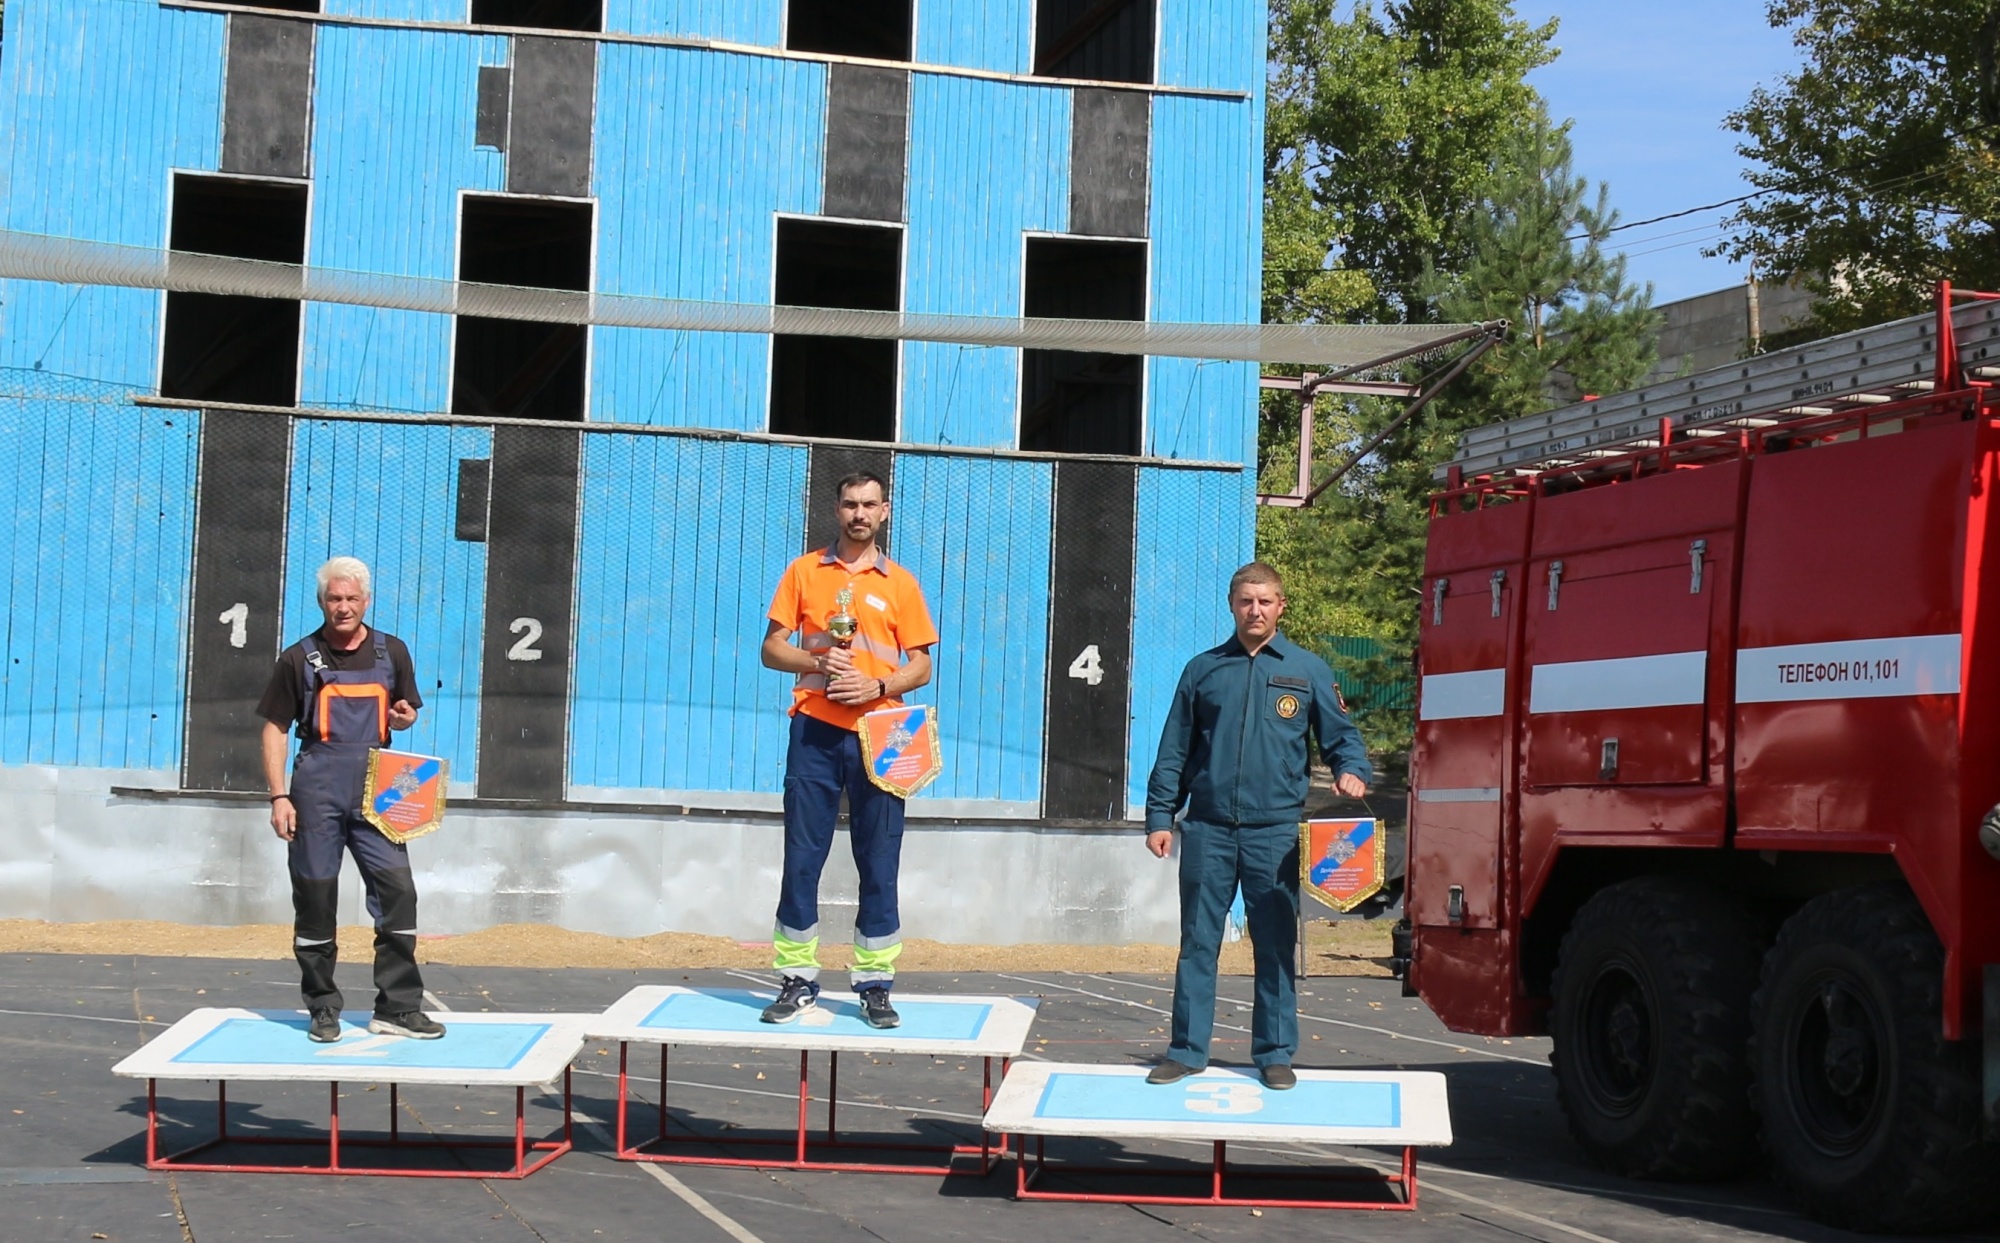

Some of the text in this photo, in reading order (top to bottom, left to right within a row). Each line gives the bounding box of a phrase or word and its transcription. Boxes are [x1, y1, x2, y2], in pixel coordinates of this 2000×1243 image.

[219, 603, 249, 648] 1
[508, 617, 543, 661] 2
[1068, 644, 1104, 685] 4
[1778, 659, 1899, 684] ТЕЛЕФОН 01,101
[1184, 1082, 1264, 1115] 3
